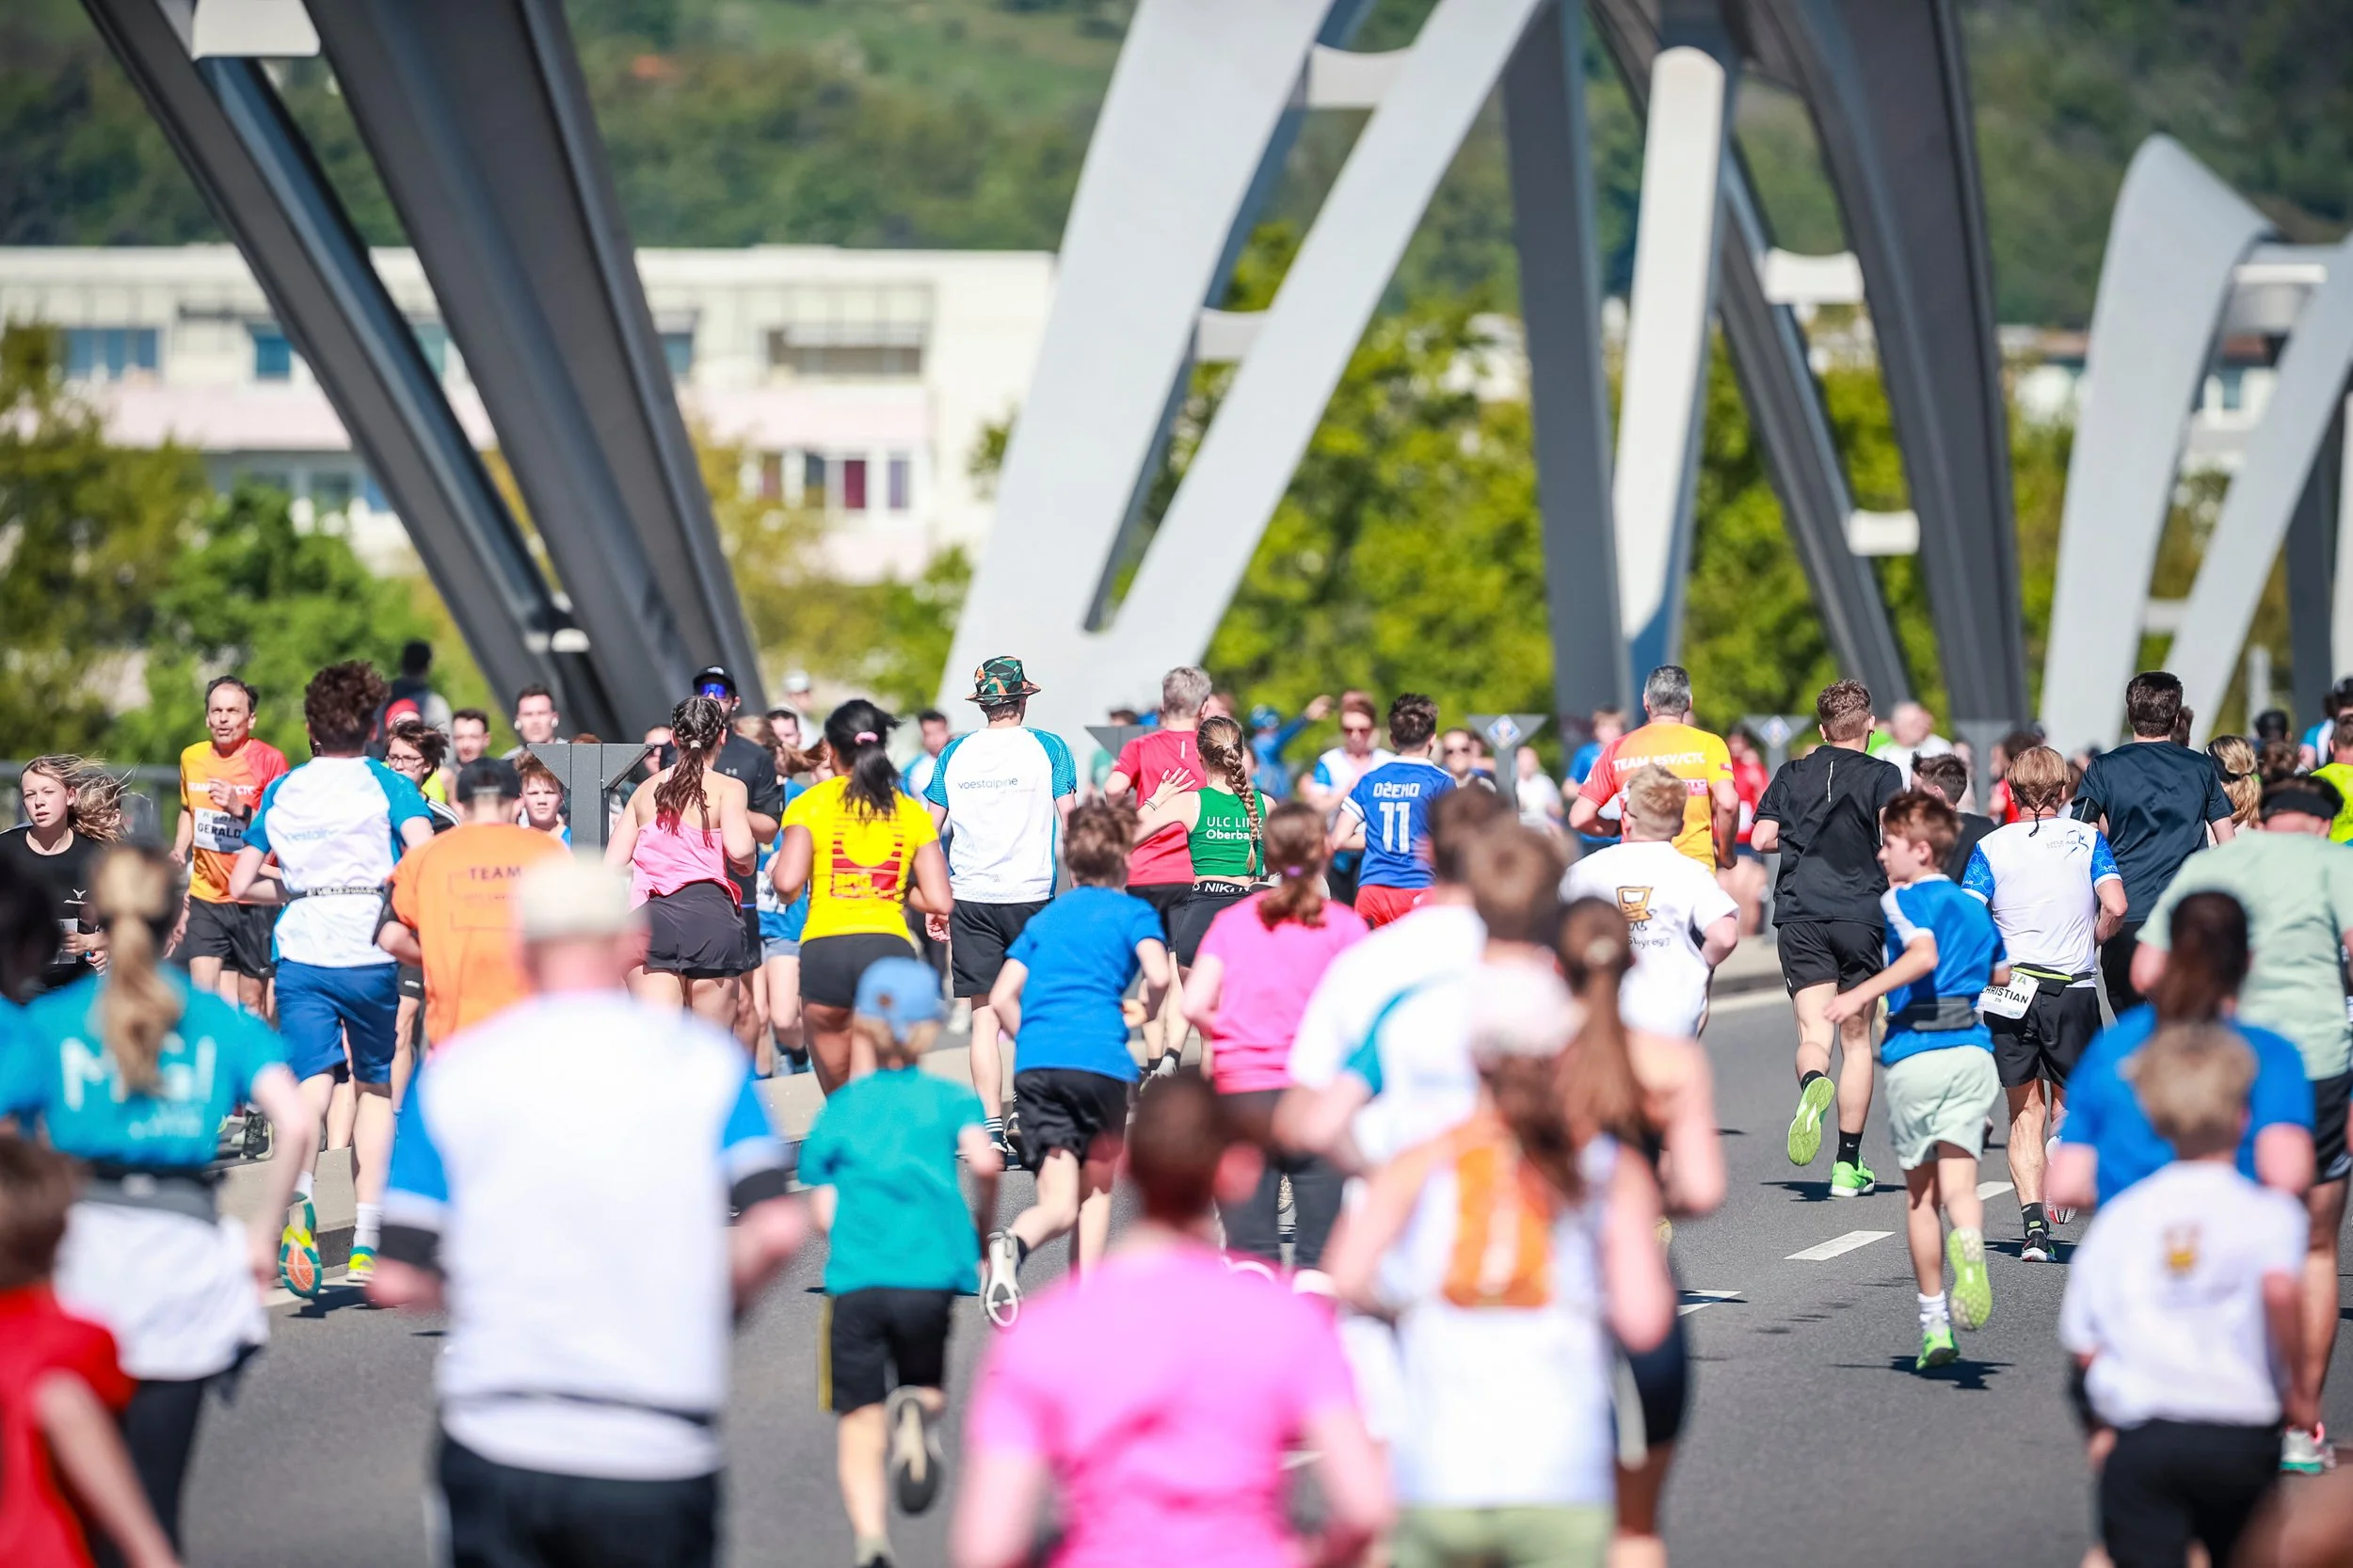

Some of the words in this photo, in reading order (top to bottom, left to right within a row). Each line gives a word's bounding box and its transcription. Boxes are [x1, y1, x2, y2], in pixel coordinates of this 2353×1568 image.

[1612, 756, 1649, 772] TEAM
[957, 777, 1018, 789] voestalpine
[1207, 816, 1230, 827] ULC
[1379, 802, 1410, 854] 11
[197, 822, 242, 839] GERALD
[1206, 828, 1263, 840] Oberbak
[471, 867, 521, 880] TEAM
